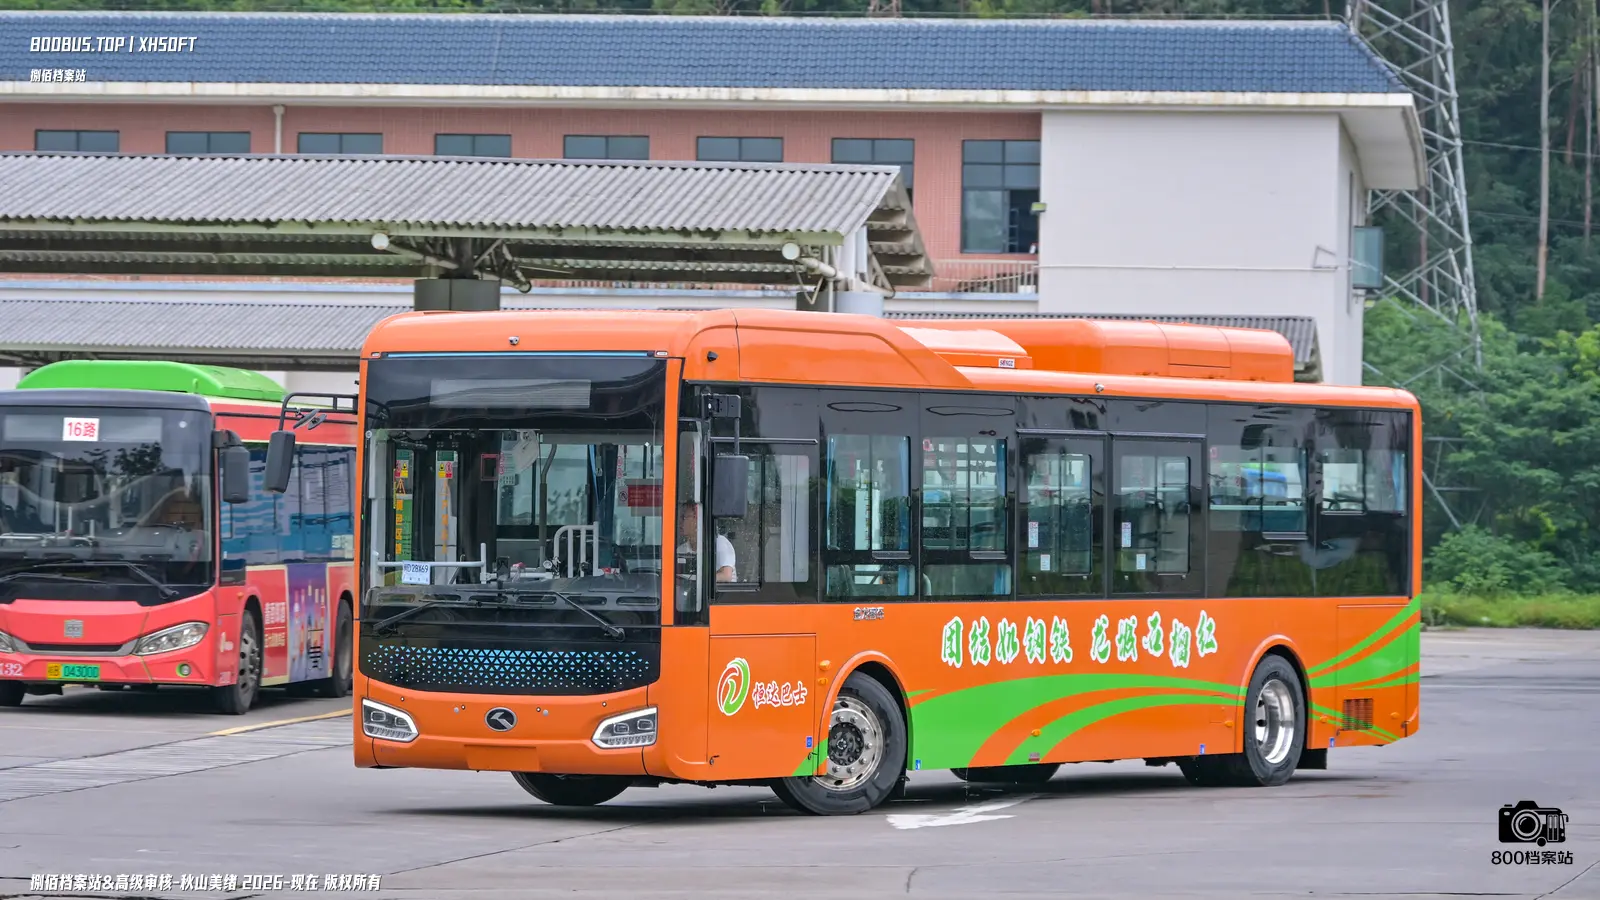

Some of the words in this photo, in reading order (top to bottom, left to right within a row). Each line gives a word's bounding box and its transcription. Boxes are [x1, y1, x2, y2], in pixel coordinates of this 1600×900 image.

[67, 421, 97, 438] 16路
[941, 616, 1073, 668] 团结如钢铁
[1090, 610, 1218, 668] 龙城石榴红
[752, 680, 808, 709] 恒达巴士
